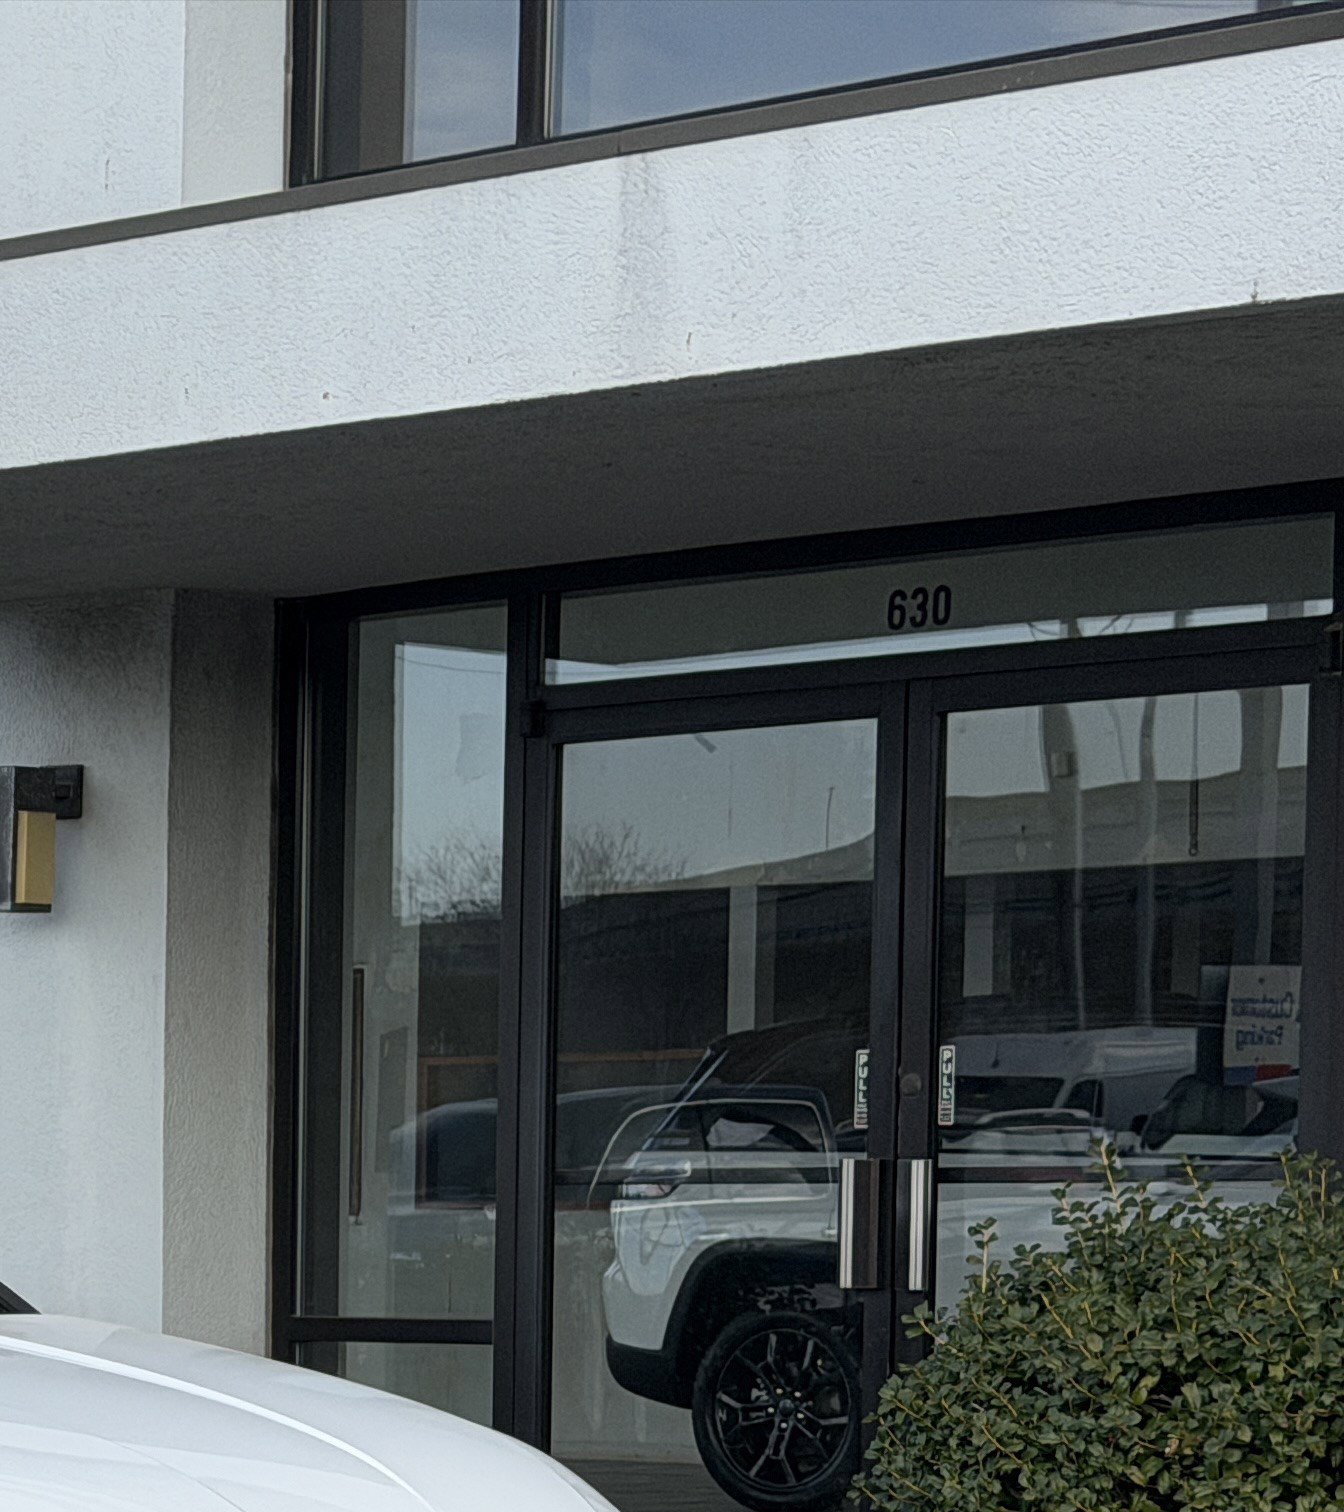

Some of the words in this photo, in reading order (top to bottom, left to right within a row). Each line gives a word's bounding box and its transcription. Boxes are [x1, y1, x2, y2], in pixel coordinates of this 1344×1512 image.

[887, 584, 952, 631] 630
[858, 1053, 869, 1103] PULL
[942, 1049, 952, 1099] PULL
